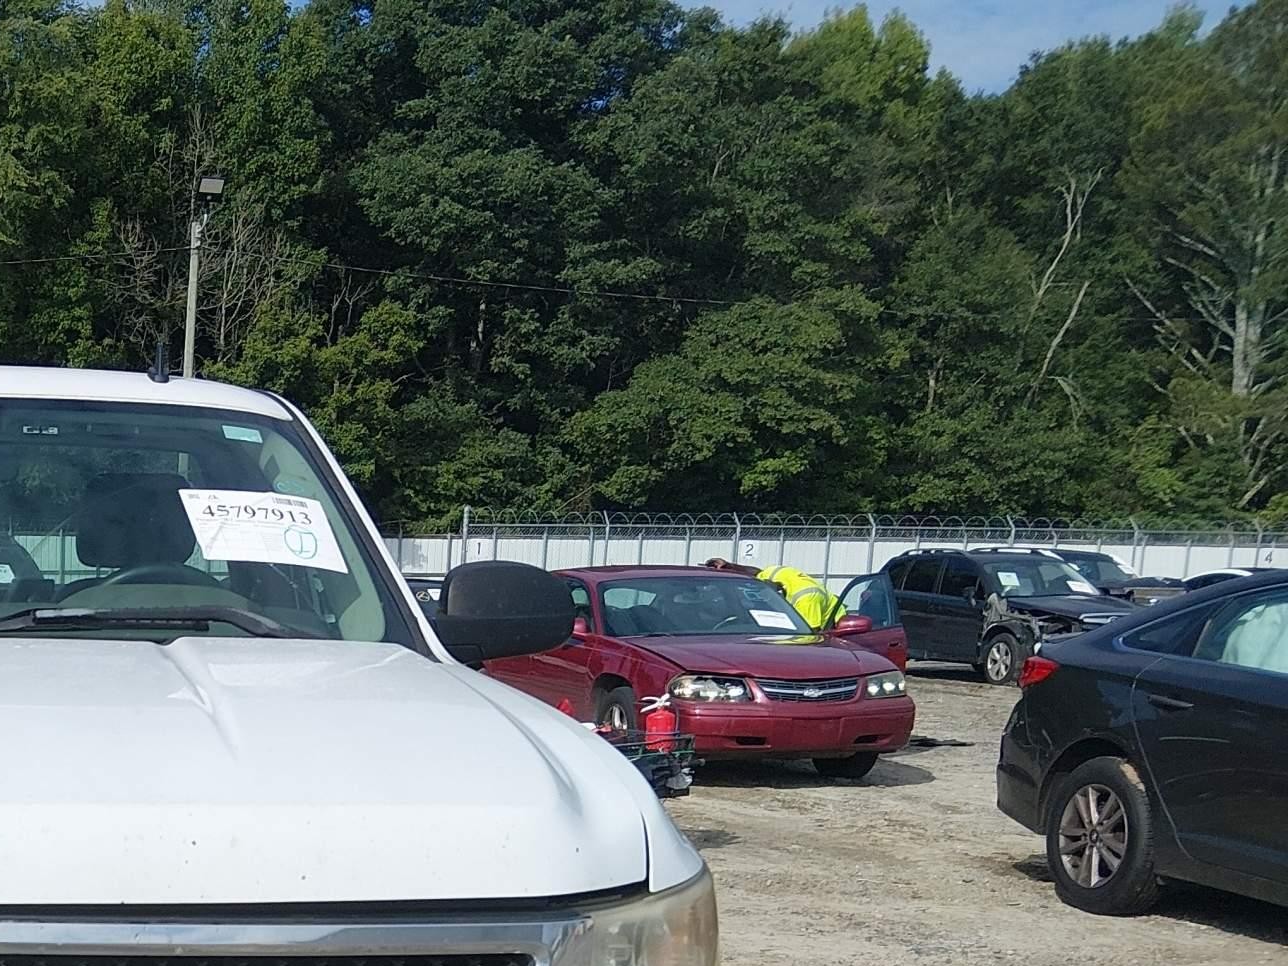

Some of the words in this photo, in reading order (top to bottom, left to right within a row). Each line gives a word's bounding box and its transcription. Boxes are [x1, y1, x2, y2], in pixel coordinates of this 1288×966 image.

[202, 504, 312, 525] 45797913
[745, 543, 754, 557] 2
[1265, 551, 1273, 563] 4
